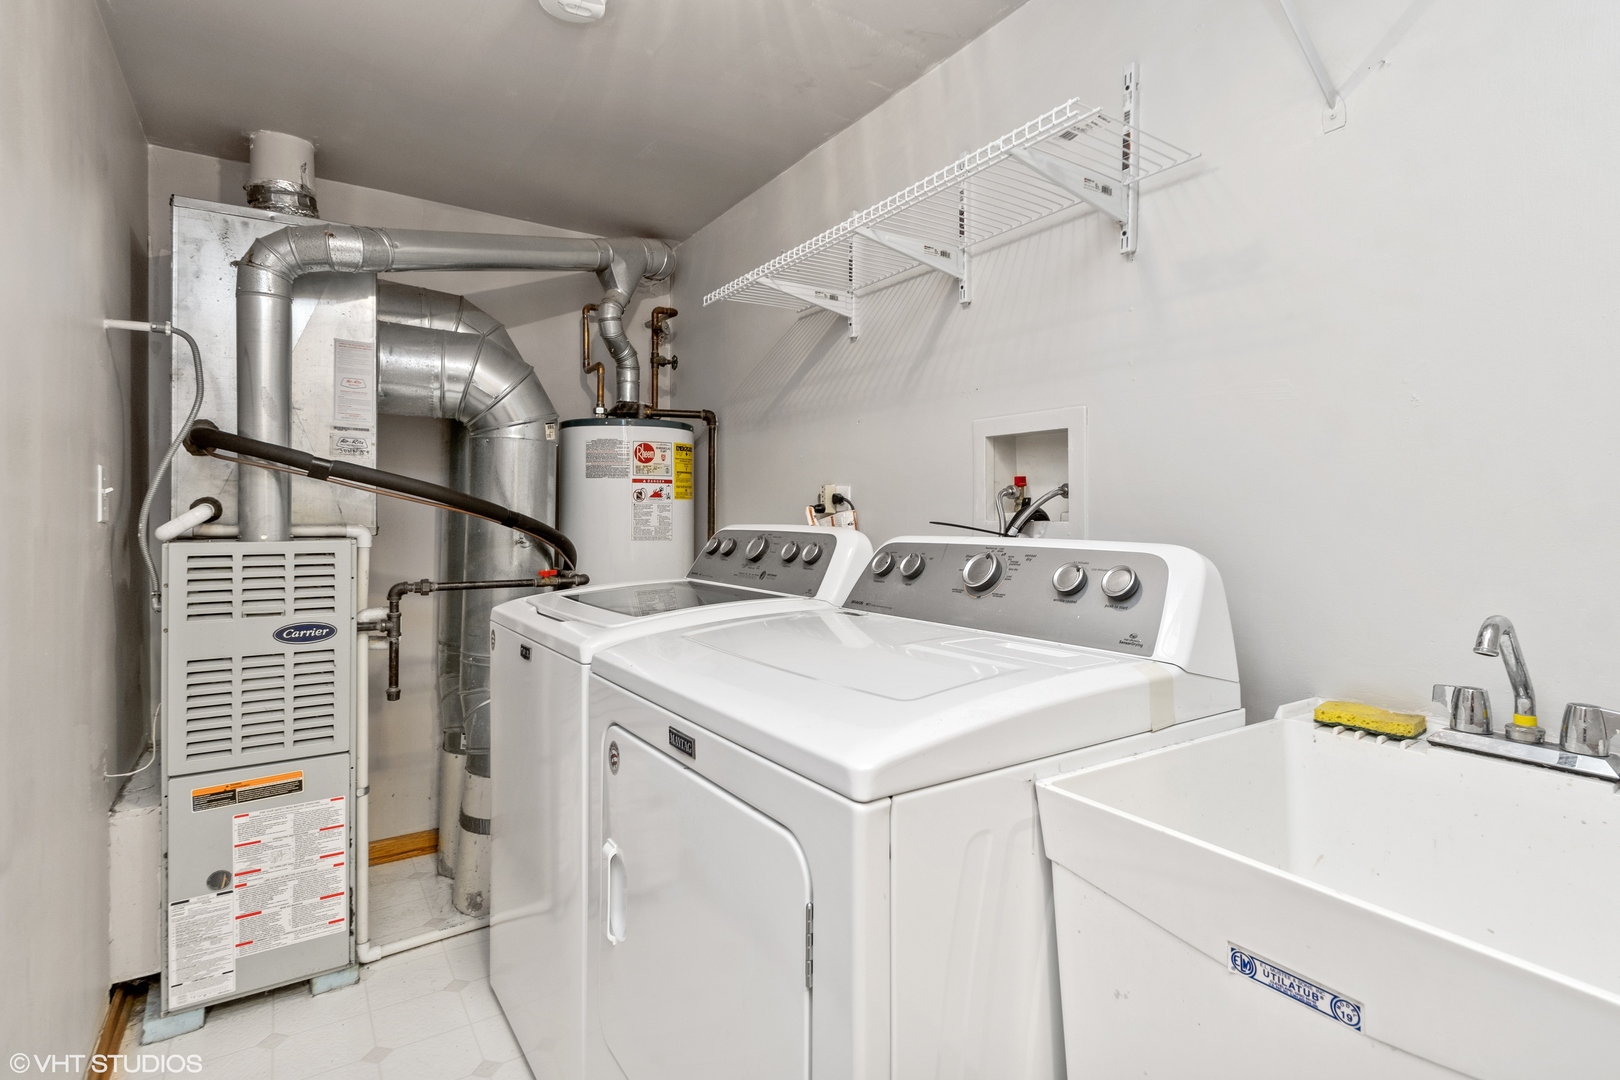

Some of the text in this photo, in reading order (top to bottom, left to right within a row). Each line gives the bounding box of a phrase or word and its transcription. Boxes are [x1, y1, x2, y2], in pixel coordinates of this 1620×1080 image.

[636, 443, 654, 461] Rheem
[283, 628, 329, 638] Carrier
[670, 732, 691, 753] MAYTAG
[1336, 1001, 1358, 1017] MODEL
[1341, 1010, 1353, 1022] 19
